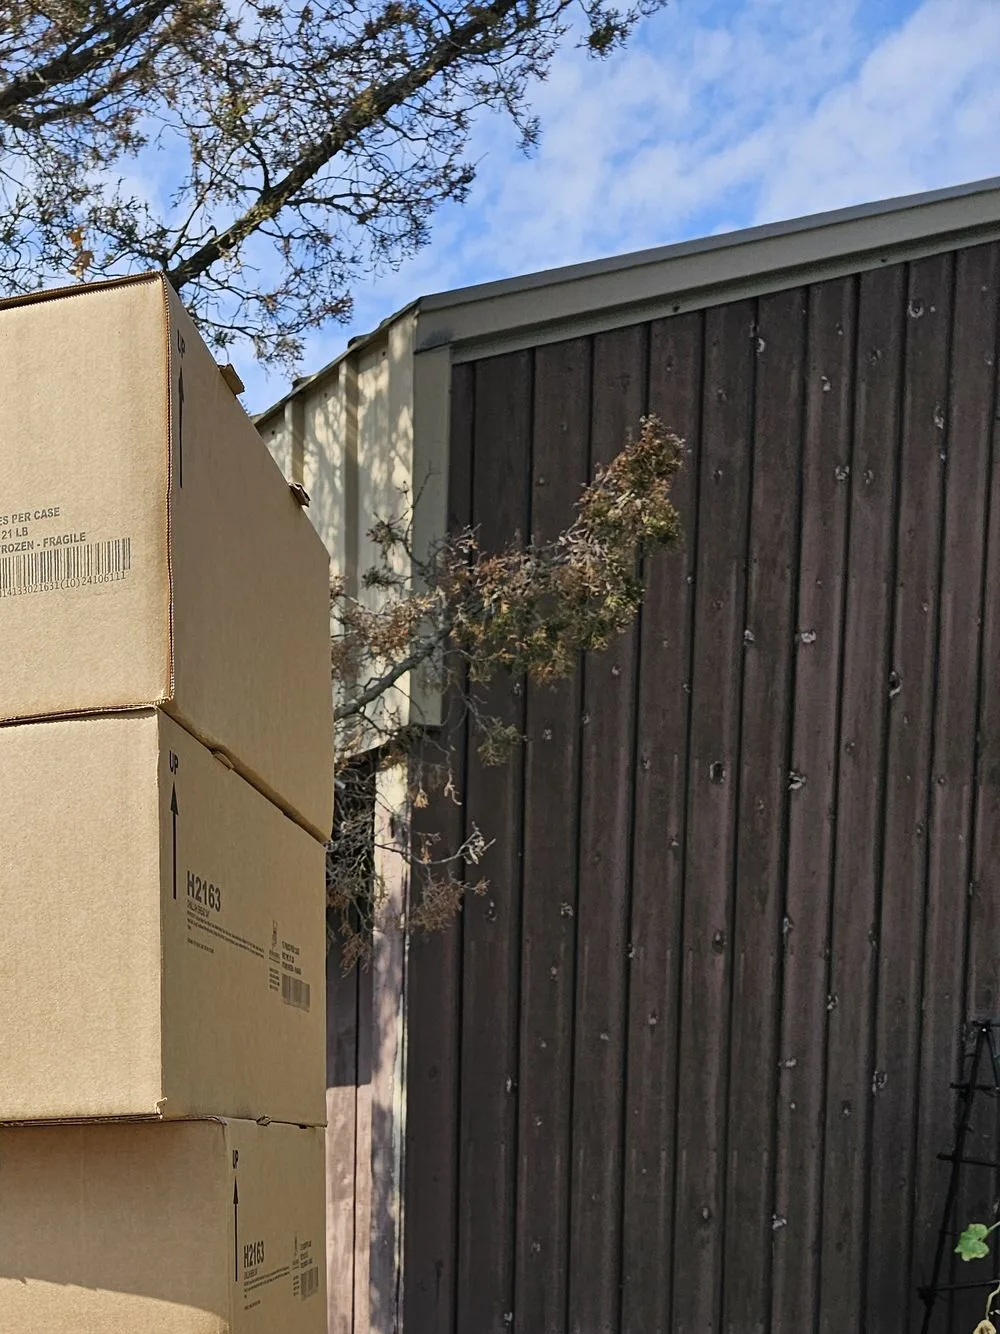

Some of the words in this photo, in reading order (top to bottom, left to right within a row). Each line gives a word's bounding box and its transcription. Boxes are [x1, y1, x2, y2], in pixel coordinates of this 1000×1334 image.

[12, 512, 31, 524] PER
[35, 507, 60, 520] CASE
[2, 529, 13, 540] 21
[16, 526, 29, 537] LB
[43, 532, 86, 547] FRAGILE
[169, 750, 178, 775] UP
[187, 870, 221, 913] H2163
[233, 1150, 239, 1170] UP
[243, 1240, 265, 1269] H2163
